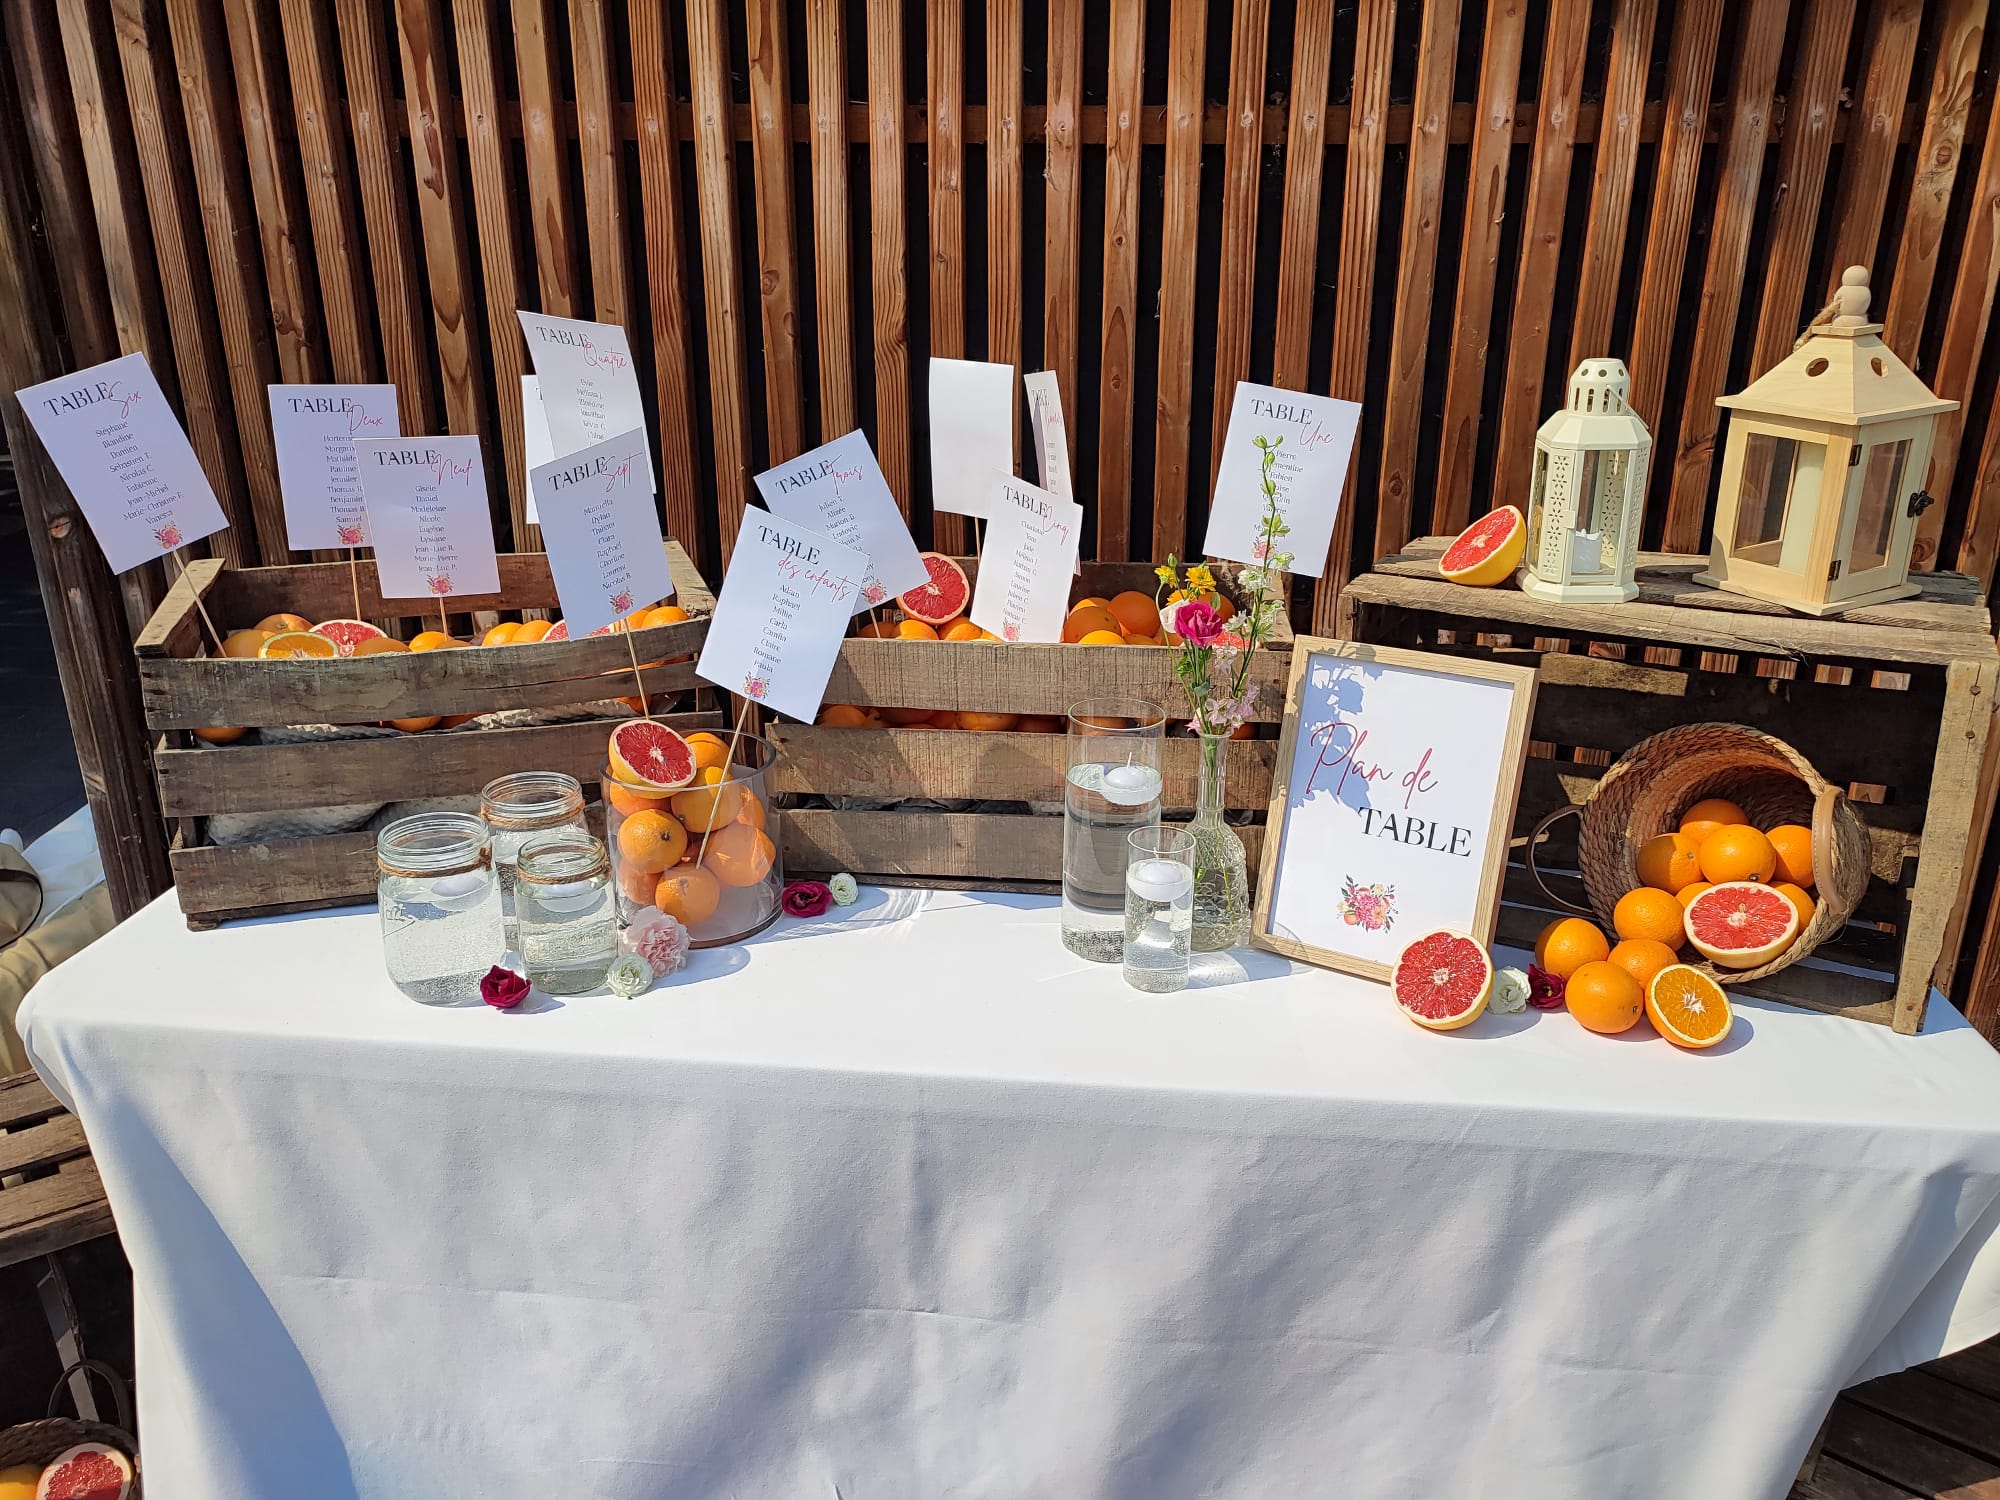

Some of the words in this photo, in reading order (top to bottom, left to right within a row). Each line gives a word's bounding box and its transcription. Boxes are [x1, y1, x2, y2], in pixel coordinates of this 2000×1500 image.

[536, 327, 592, 349] TABLE
[583, 341, 627, 376] Quatre
[44, 382, 114, 416] TABLE
[108, 380, 142, 419] Six
[288, 397, 352, 413] TABLE
[347, 404, 383, 435] Deux
[1251, 399, 1313, 425] TABLE
[1299, 420, 1335, 451] Une
[374, 450, 437, 466] TABLE
[431, 454, 472, 486] Neuf
[548, 456, 608, 491] TABLE
[601, 451, 643, 493] Sept
[775, 460, 834, 494] TABLE
[826, 454, 863, 495] Trois
[336, 515, 362, 523] Samuel
[1003, 485, 1048, 517] TABLE
[1042, 505, 1069, 546] Cinq
[758, 525, 821, 565] TABLE
[777, 552, 801, 579] des
[804, 569, 860, 603] enfants
[1305, 722, 1394, 795] Plan
[1402, 747, 1438, 809] de
[1358, 806, 1472, 857] TABLE
